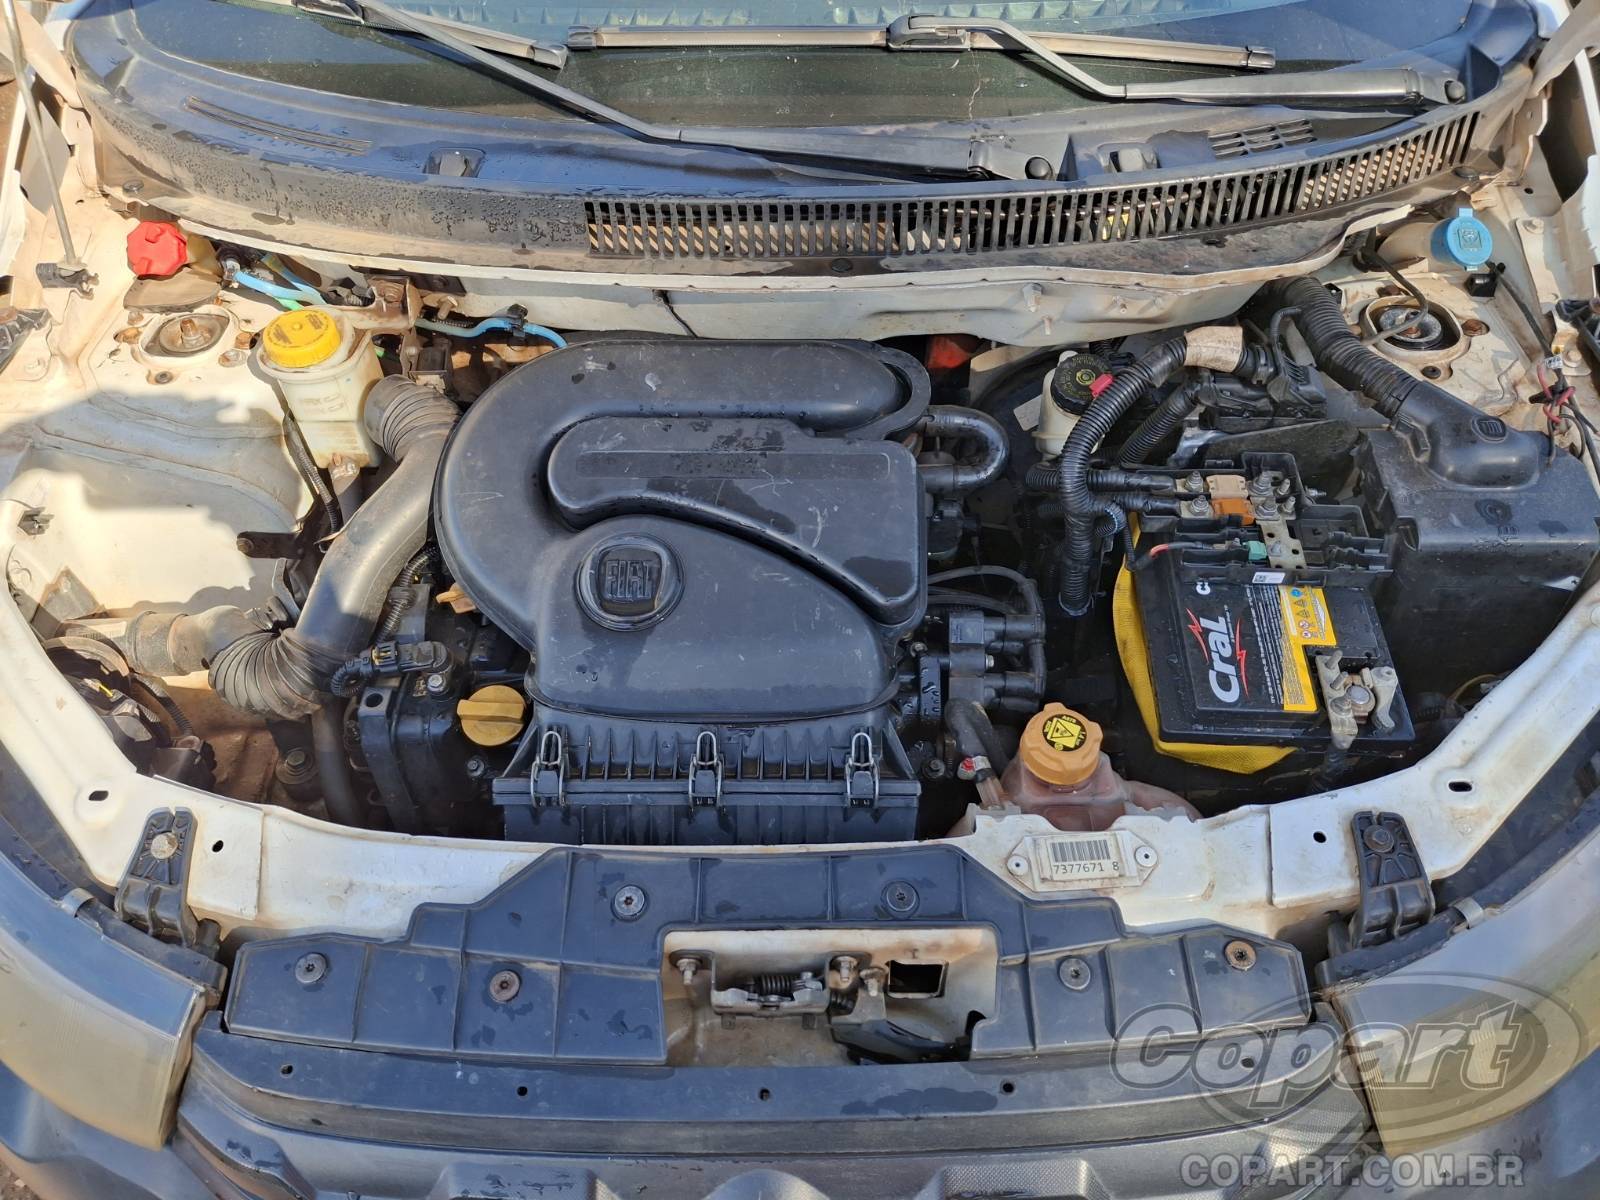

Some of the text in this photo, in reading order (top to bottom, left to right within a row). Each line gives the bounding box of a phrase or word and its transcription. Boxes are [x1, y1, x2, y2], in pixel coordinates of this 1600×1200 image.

[604, 559, 660, 600] FIAT
[1053, 861, 1120, 875] 7377671 8
